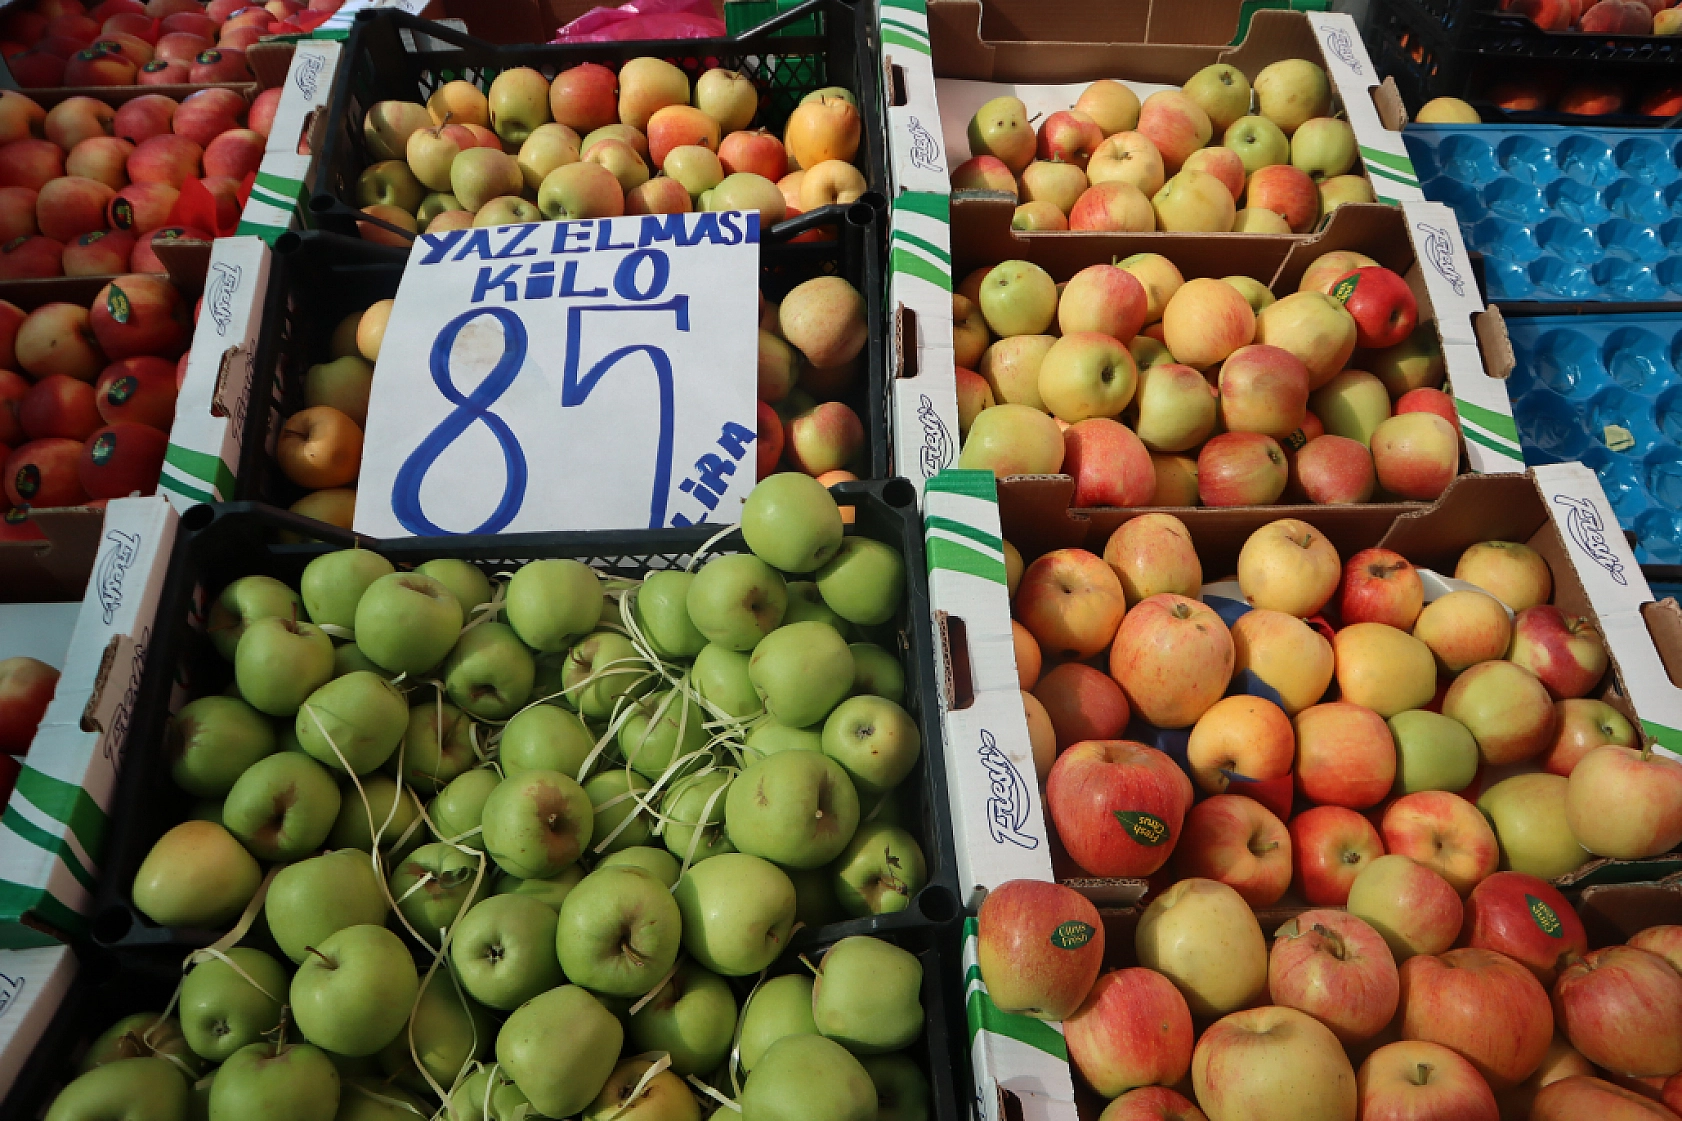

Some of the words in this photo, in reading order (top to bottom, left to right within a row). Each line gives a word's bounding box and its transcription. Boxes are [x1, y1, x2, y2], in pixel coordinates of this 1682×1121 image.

[418, 223, 541, 266] YAZ
[550, 210, 761, 254] ELMASI
[470, 249, 671, 303] KİLO
[391, 294, 691, 538] 85
